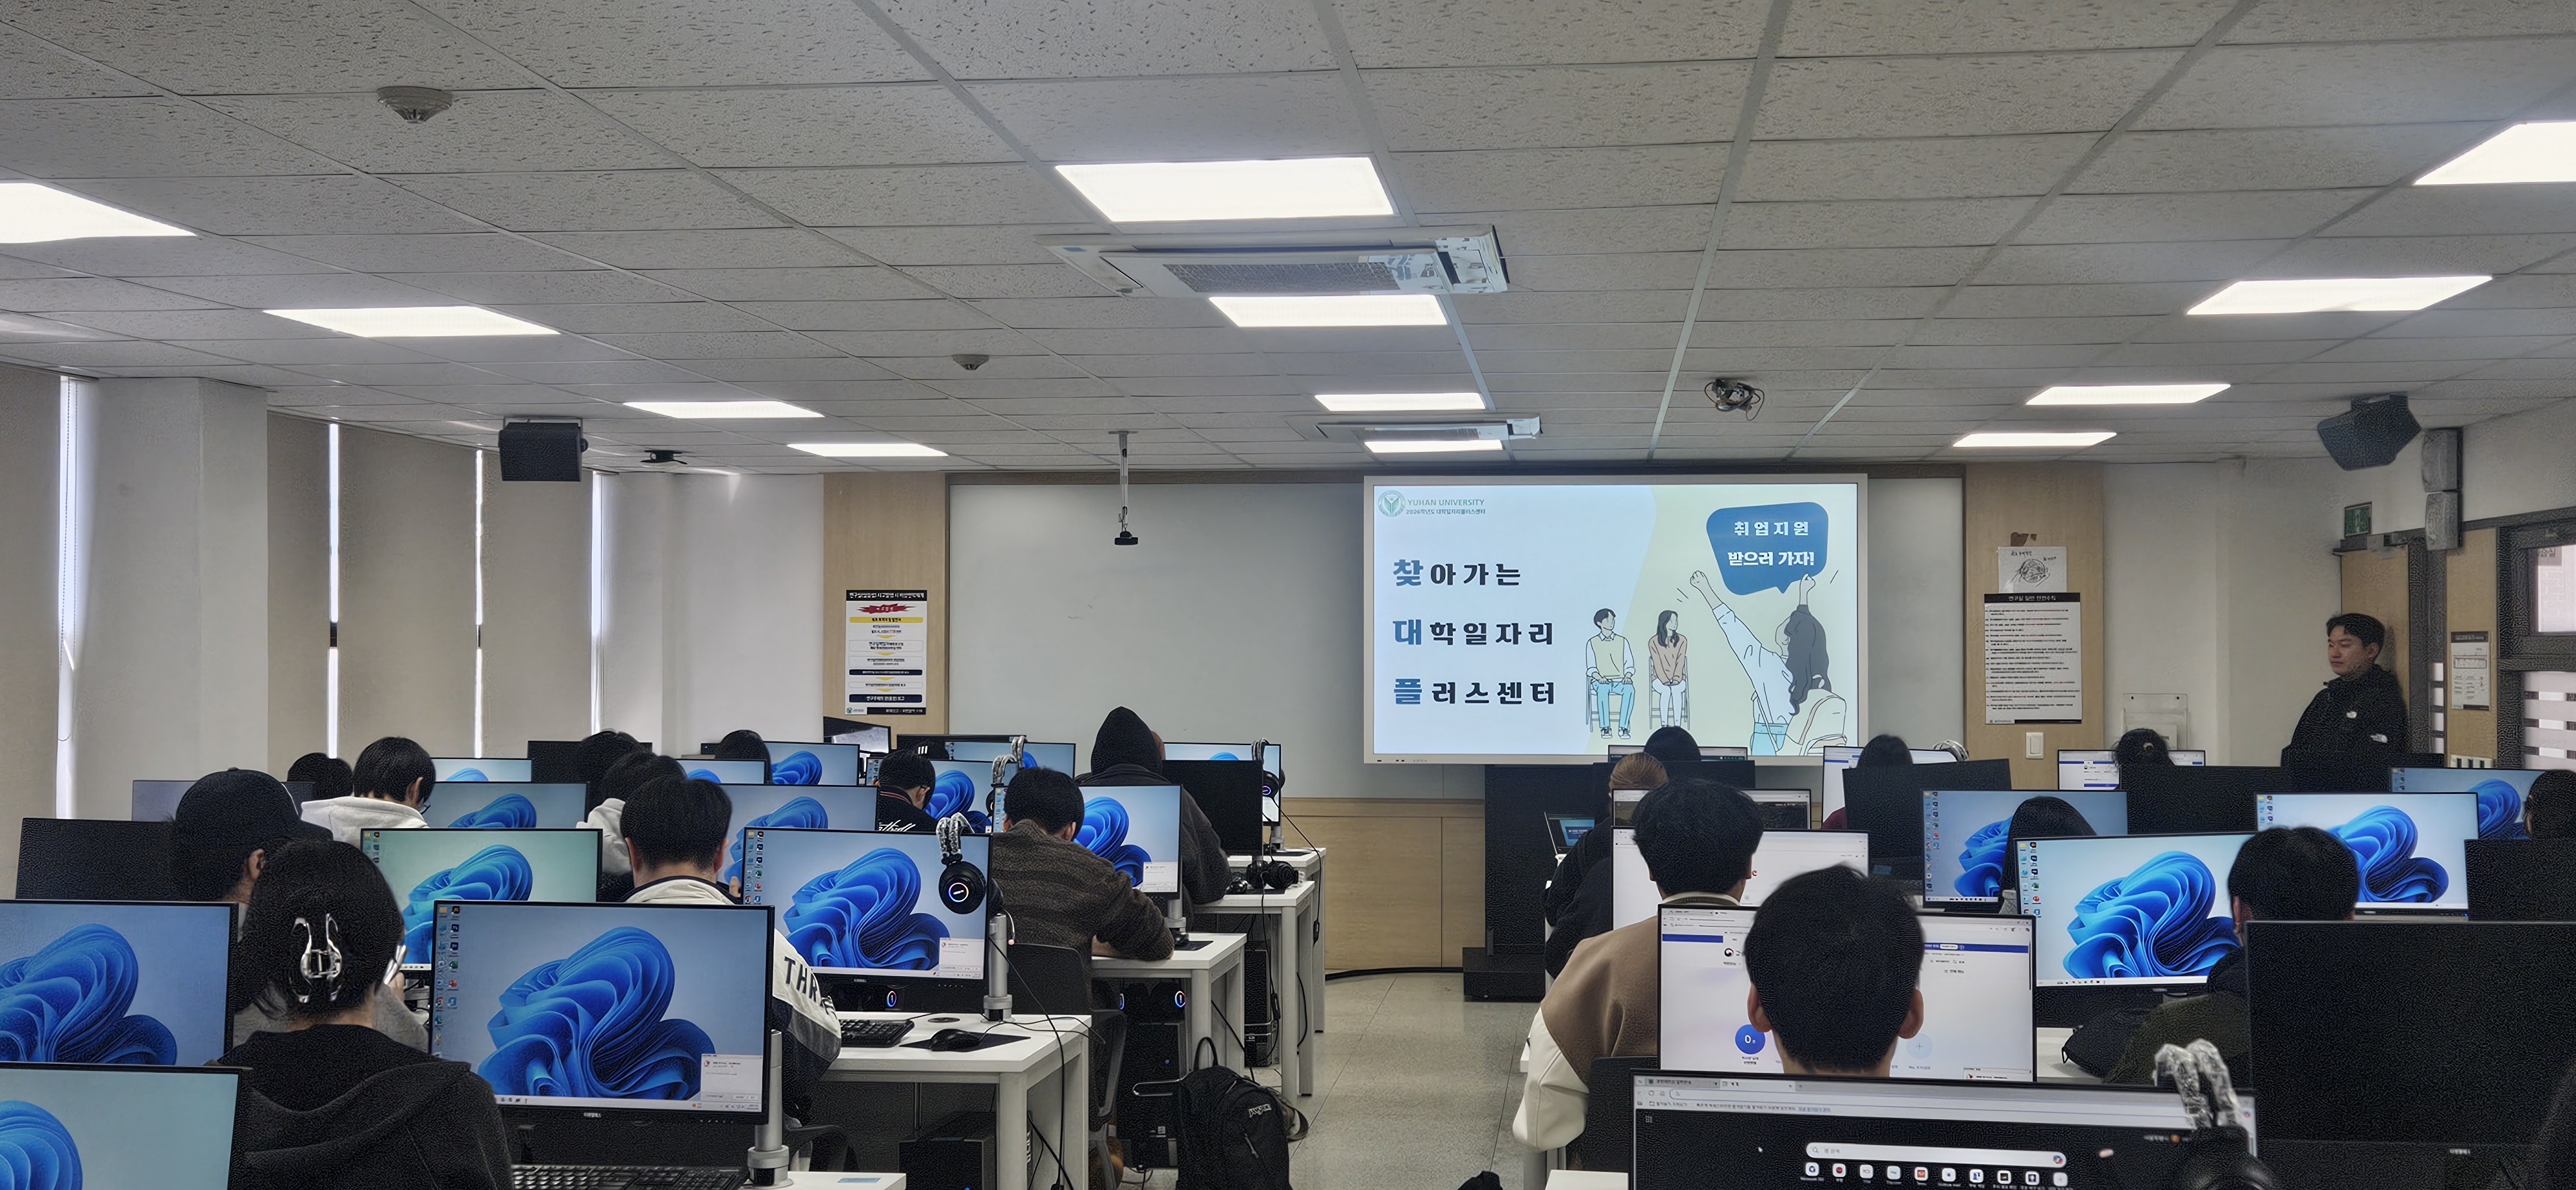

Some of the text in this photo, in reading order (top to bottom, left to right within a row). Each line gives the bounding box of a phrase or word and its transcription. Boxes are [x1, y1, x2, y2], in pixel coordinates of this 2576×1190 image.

[1728, 551, 1814, 567] 받으러 가자!
[1393, 559, 1521, 587] 찾아가는
[1392, 619, 1553, 646] 대학일자리
[1394, 678, 1554, 705] 플러스센터
